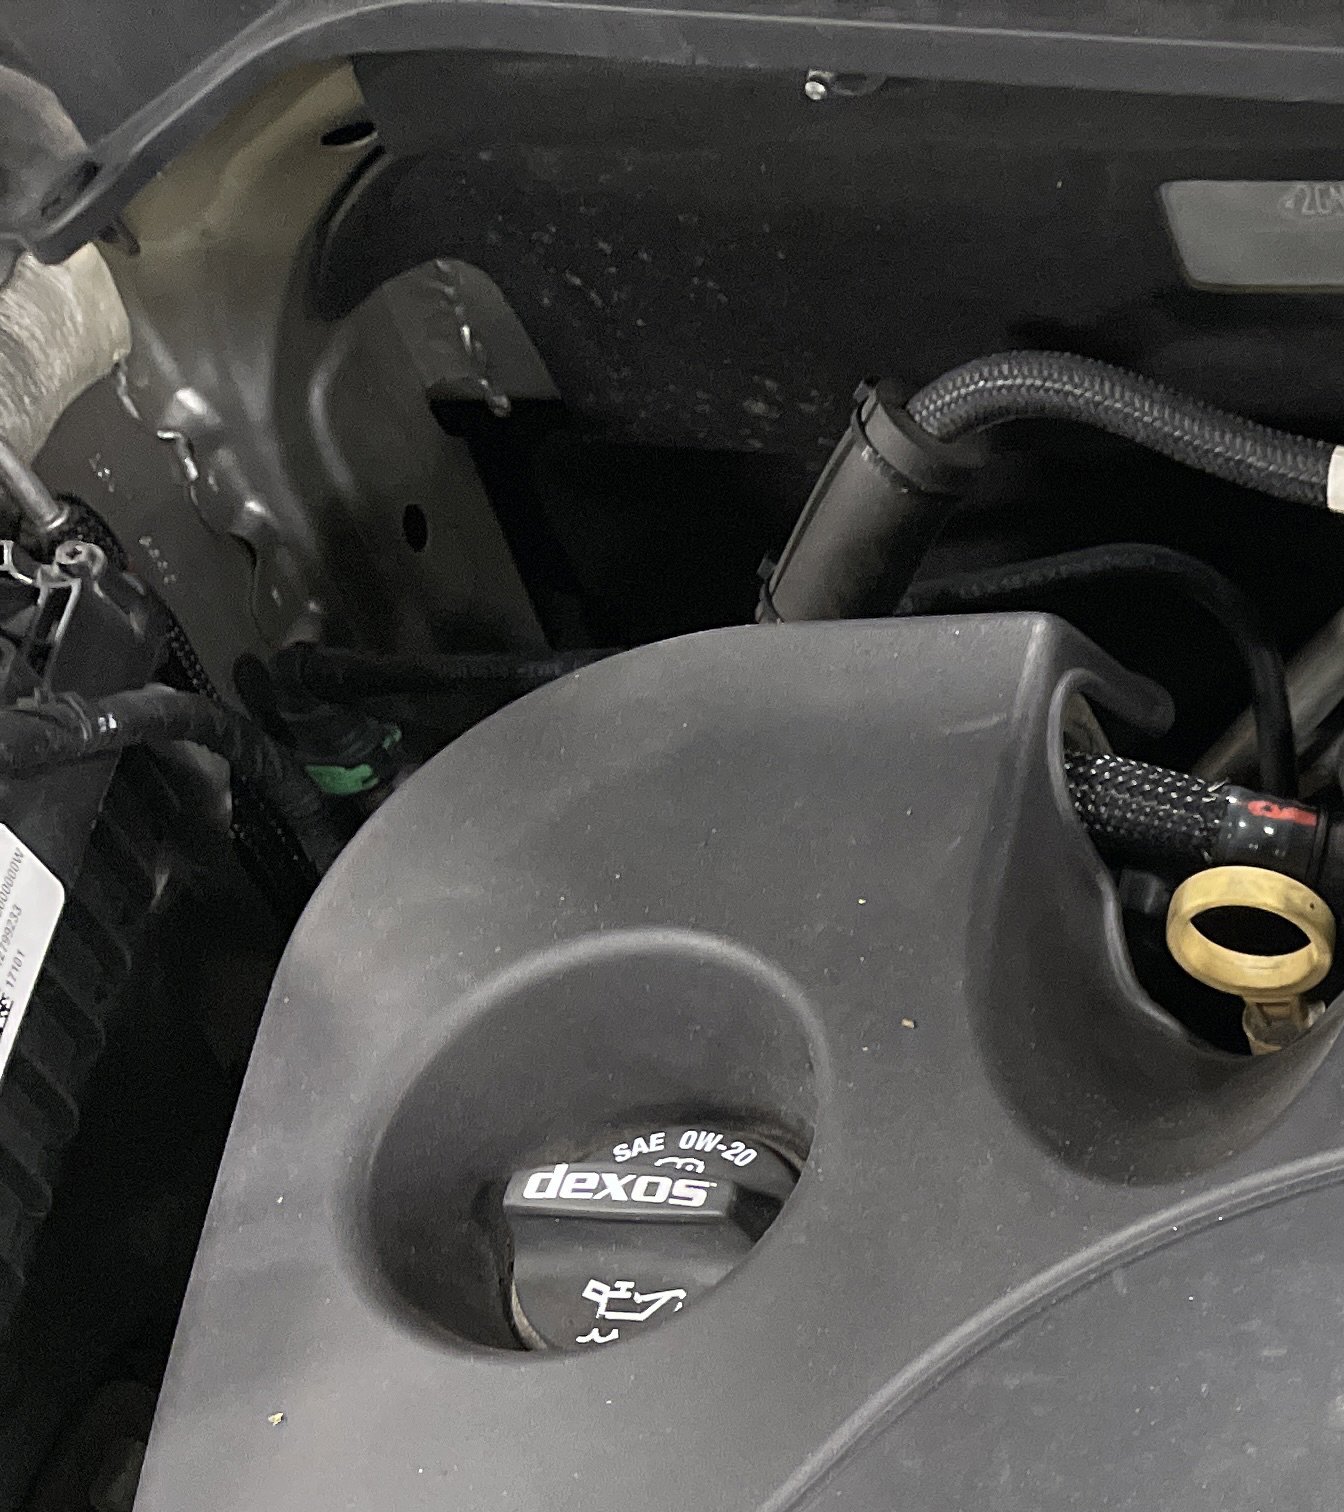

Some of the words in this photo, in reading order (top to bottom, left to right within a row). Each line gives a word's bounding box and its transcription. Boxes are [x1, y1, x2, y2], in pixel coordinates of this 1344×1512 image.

[612, 1131, 666, 1163] SAE
[678, 1129, 758, 1168] 0W-20
[521, 1163, 717, 1208] dexos
